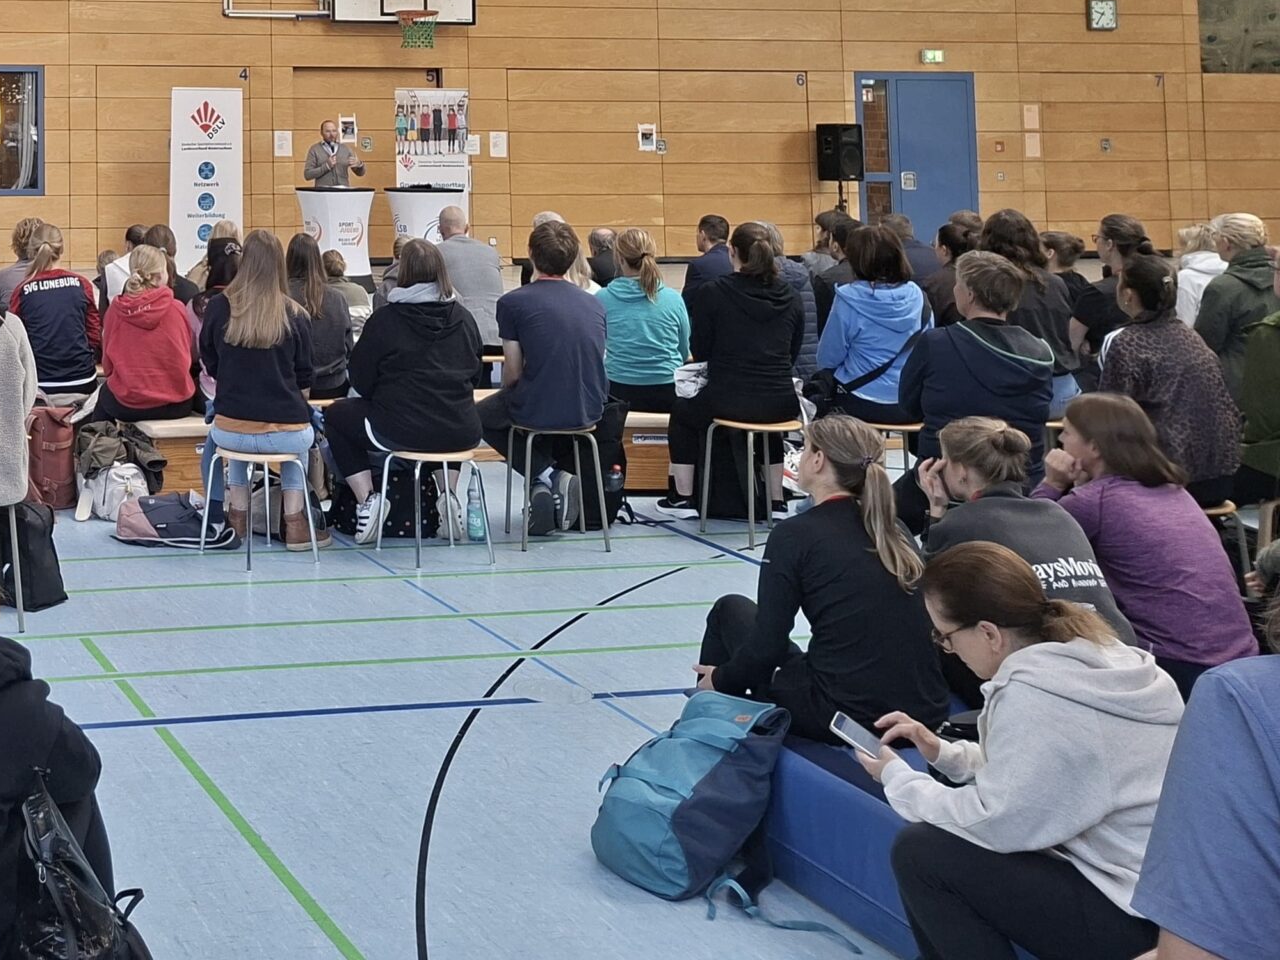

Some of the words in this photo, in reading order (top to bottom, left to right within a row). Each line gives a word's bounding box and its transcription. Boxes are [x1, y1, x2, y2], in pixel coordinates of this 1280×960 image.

[239, 68, 248, 81] 4
[426, 70, 435, 82] 5
[796, 74, 805, 86] 6
[1155, 75, 1162, 87] 7
[207, 118, 226, 139] DSLV
[23, 281, 38, 295] SVG
